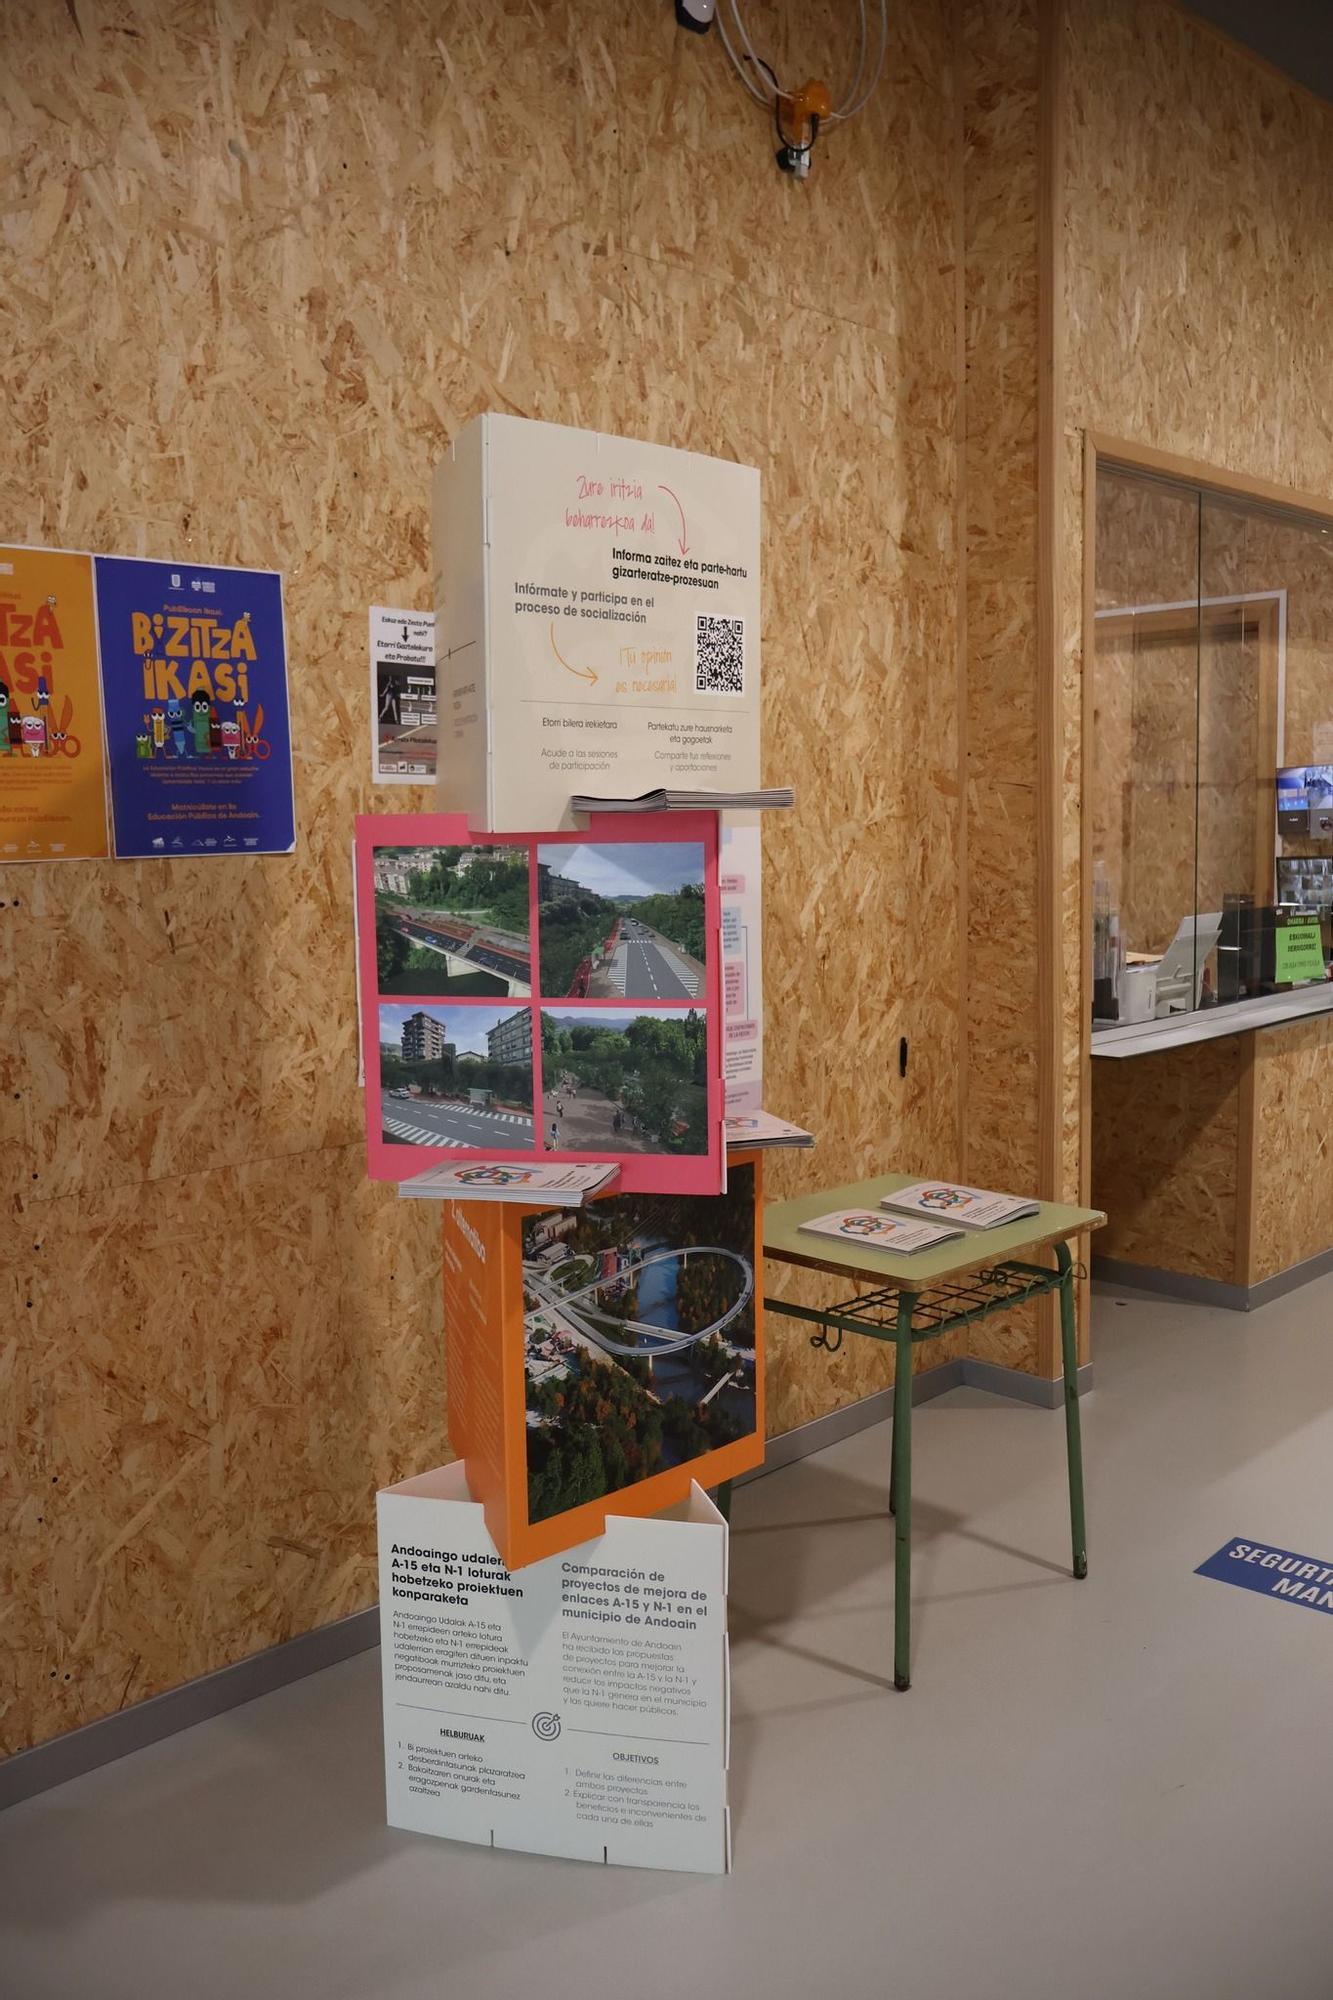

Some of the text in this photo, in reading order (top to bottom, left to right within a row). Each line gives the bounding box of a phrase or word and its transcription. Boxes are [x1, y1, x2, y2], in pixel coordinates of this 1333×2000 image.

[612, 548, 748, 578] Informa zaitez eta parte-hartu
[612, 566, 719, 589] gizarteratze-prozesuan
[515, 582, 655, 607] Infórmate y participa en el
[515, 602, 647, 623] proceso de socialización
[562, 718, 584, 728] bilera
[680, 724, 694, 732] zure
[669, 735, 713, 745] eta gogoetak
[541, 748, 567, 758] Acude
[576, 749, 587, 758] las
[549, 761, 610, 771] de participación
[391, 1544, 506, 1566] Andoaingo udaler
[392, 1558, 511, 1581] A-15 eta N-1 loturak
[562, 1562, 665, 1582] Comparación de
[392, 1572, 523, 1598] hobetzeko proiektuen
[562, 1578, 707, 1600] proyectos de mejora de
[392, 1587, 469, 1605] konparaketa
[561, 1594, 708, 1616] enlaces A-15 y N-1 en el
[393, 1610, 437, 1624] Andoaingo
[468, 1620, 486, 1630] A-15
[487, 1623, 501, 1632] eta
[562, 1608, 697, 1630] municipio de Andoain
[394, 1631, 433, 1643] hobetzeko
[435, 1637, 449, 1645] eta
[466, 1642, 509, 1653] errepideak
[408, 1624, 450, 1635] errepideen
[452, 1630, 477, 1639] arteko
[479, 1632, 502, 1641] lotura
[570, 1632, 682, 1651] Ayuntamiento de Andoain
[394, 1643, 434, 1654] udalerrian
[435, 1649, 468, 1659] eragiten
[394, 1663, 454, 1678] proposamenak
[492, 1677, 506, 1685] eta
[618, 1661, 639, 1670] para
[394, 1673, 442, 1687] jendaurrean
[444, 1681, 472, 1691] azaldu
[440, 1728, 485, 1742] HELBURUAK
[407, 1743, 483, 1763] Bi proiektuen arteko
[612, 1752, 660, 1765] OBJETIVOS
[407, 1754, 526, 1780] desberdintasunak plazaratzea
[408, 1763, 496, 1785] Bakoitzaren onurak eta
[408, 1775, 521, 1799] eragozpenak gardentasunez
